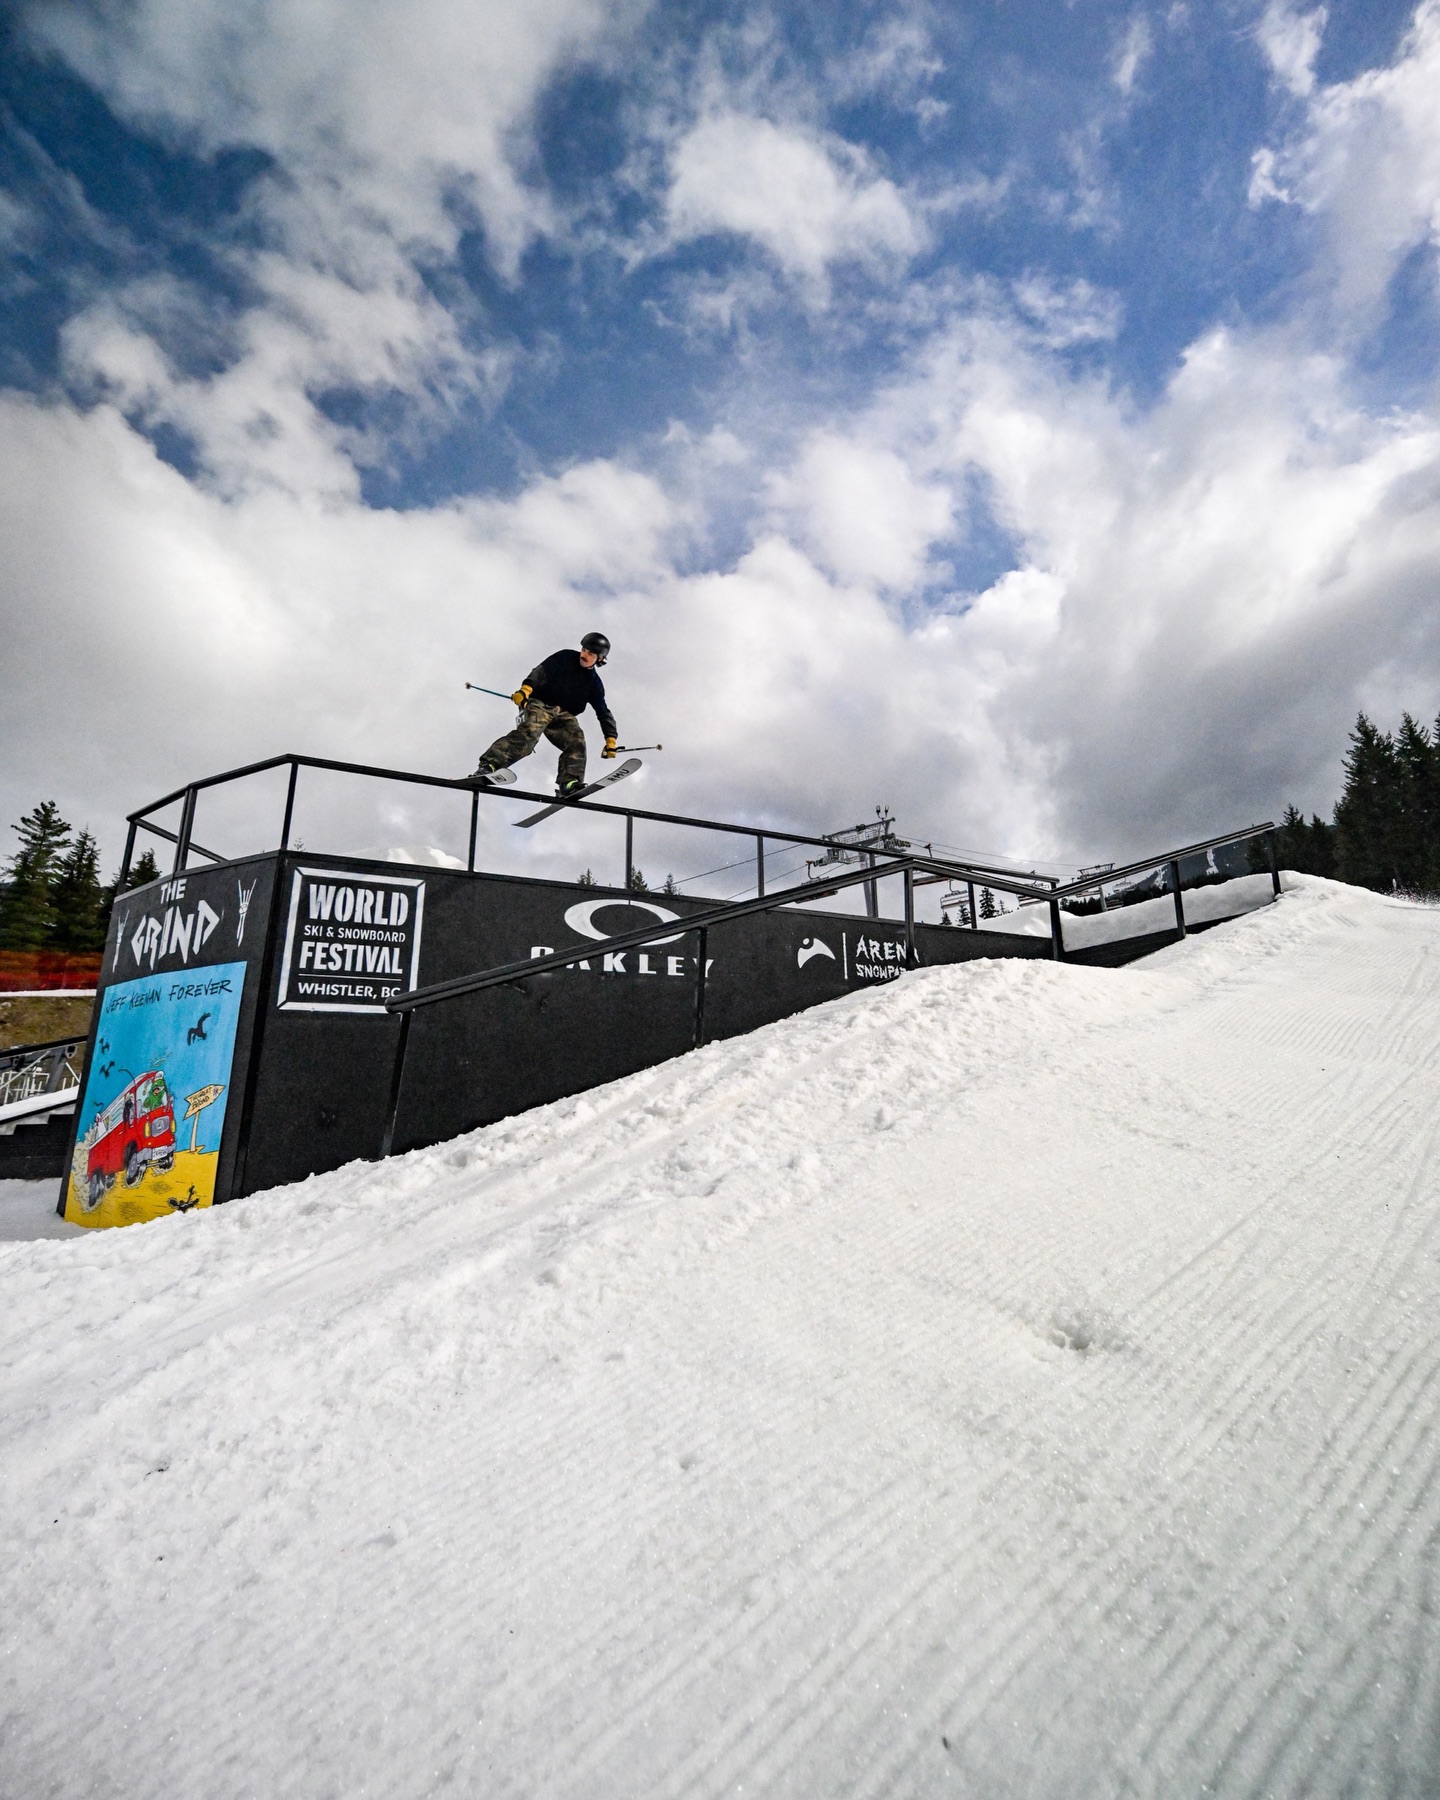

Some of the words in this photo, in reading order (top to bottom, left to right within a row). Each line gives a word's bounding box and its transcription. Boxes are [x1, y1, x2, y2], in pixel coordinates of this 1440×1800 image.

[607, 769, 630, 782] RMU
[160, 878, 187, 904] THE
[309, 883, 409, 926] WORLD
[131, 899, 220, 971] GRIND
[304, 924, 323, 937] SKI
[326, 926, 334, 938] &
[337, 927, 406, 943] SNOWBOARD
[299, 940, 403, 974] FESTIVAL
[855, 963, 907, 979] SNOWPA
[106, 993, 127, 1014] JEFF
[169, 978, 233, 1001] FOREVER
[298, 982, 377, 999] WHISTLER,
[381, 986, 401, 998] BC
